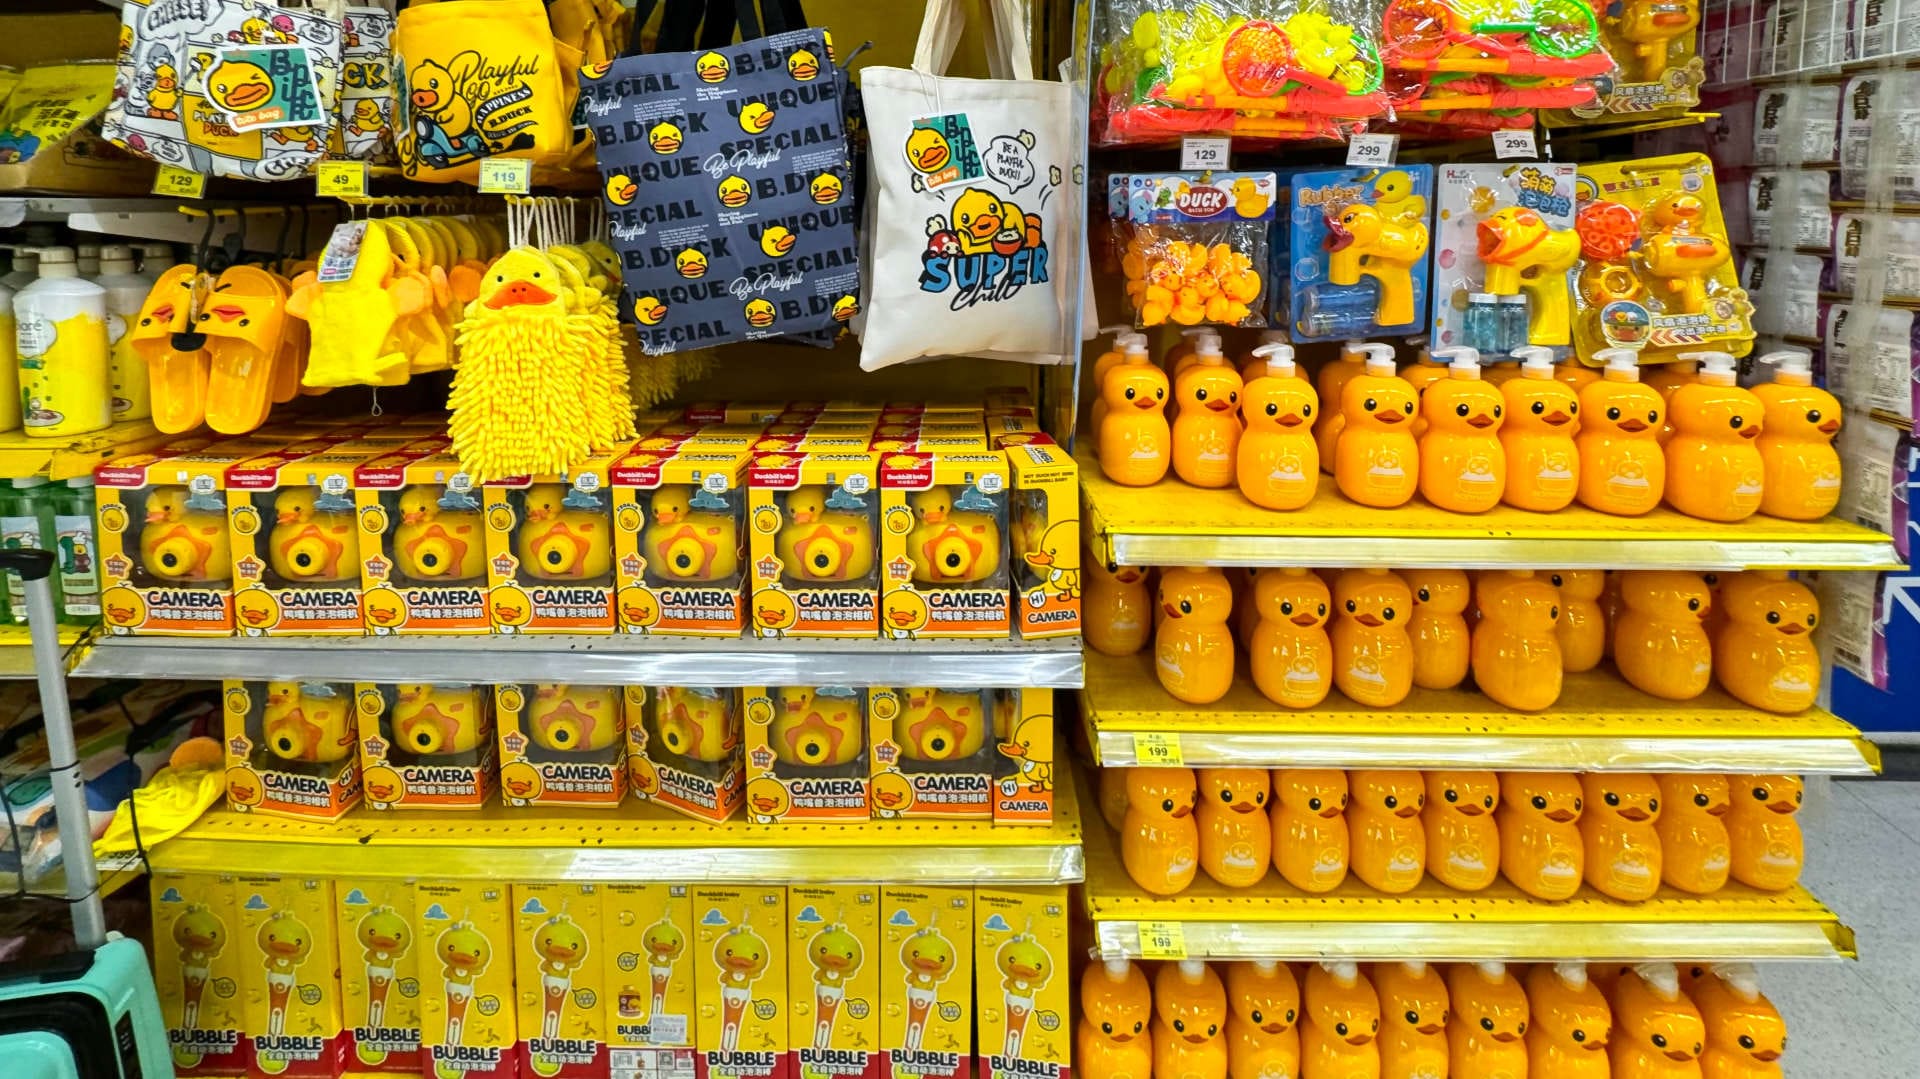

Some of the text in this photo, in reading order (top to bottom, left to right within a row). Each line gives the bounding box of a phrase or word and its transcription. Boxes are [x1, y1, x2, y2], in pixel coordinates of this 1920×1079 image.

[450, 50, 540, 100] Playful
[476, 87, 532, 124] HAPPINESS
[488, 106, 534, 128] B.DUCK
[597, 112, 710, 147] B.DCK
[1003, 142, 1019, 154] BE A
[1357, 145, 1380, 156] 299
[1505, 138, 1528, 149] 299
[730, 148, 782, 172] Playful
[1193, 149, 1216, 160] 129
[169, 174, 193, 187] 129
[332, 174, 350, 184] 49
[492, 171, 517, 183] 119
[1180, 193, 1223, 208] DUCK
[1300, 186, 1363, 206] Rubber
[623, 237, 732, 270] B.DCK
[919, 245, 1049, 293] SUPER
[753, 271, 803, 295] Playful
[950, 281, 1022, 311] Chill
[147, 591, 224, 608] CAMERA
[280, 591, 358, 607] CAMERA
[407, 591, 483, 606] CAMERA
[532, 590, 607, 605] CAMERA
[660, 591, 735, 607] CAMERA
[796, 592, 874, 607] CAMERA
[929, 592, 1006, 607] CAMERA
[1031, 593, 1044, 604] HI
[1028, 610, 1077, 624] CAMERA
[1148, 747, 1168, 756] 199
[403, 768, 475, 783] CAMERA
[542, 765, 612, 780] CAMERA
[263, 773, 330, 795] CAMERA
[658, 766, 716, 797] CAMERA
[790, 781, 864, 796] CAMERA
[913, 775, 988, 791] CAMERA
[1003, 783, 1016, 793] HI
[999, 801, 1048, 812] CAMERA
[1152, 937, 1171, 947] 199
[170, 1029, 236, 1044] BUBBLE
[355, 1027, 420, 1042] BUBBLE
[617, 1025, 651, 1034] BUBB
[256, 1035, 322, 1051] BUBBLE
[530, 1039, 596, 1054] BUBBLE
[433, 1046, 499, 1061] BUBBLE
[708, 1050, 775, 1067] BUBBLE
[800, 1048, 867, 1066] BUBBLE
[891, 1048, 958, 1066] BUBBLE
[991, 1056, 1058, 1077] BUBBLE
